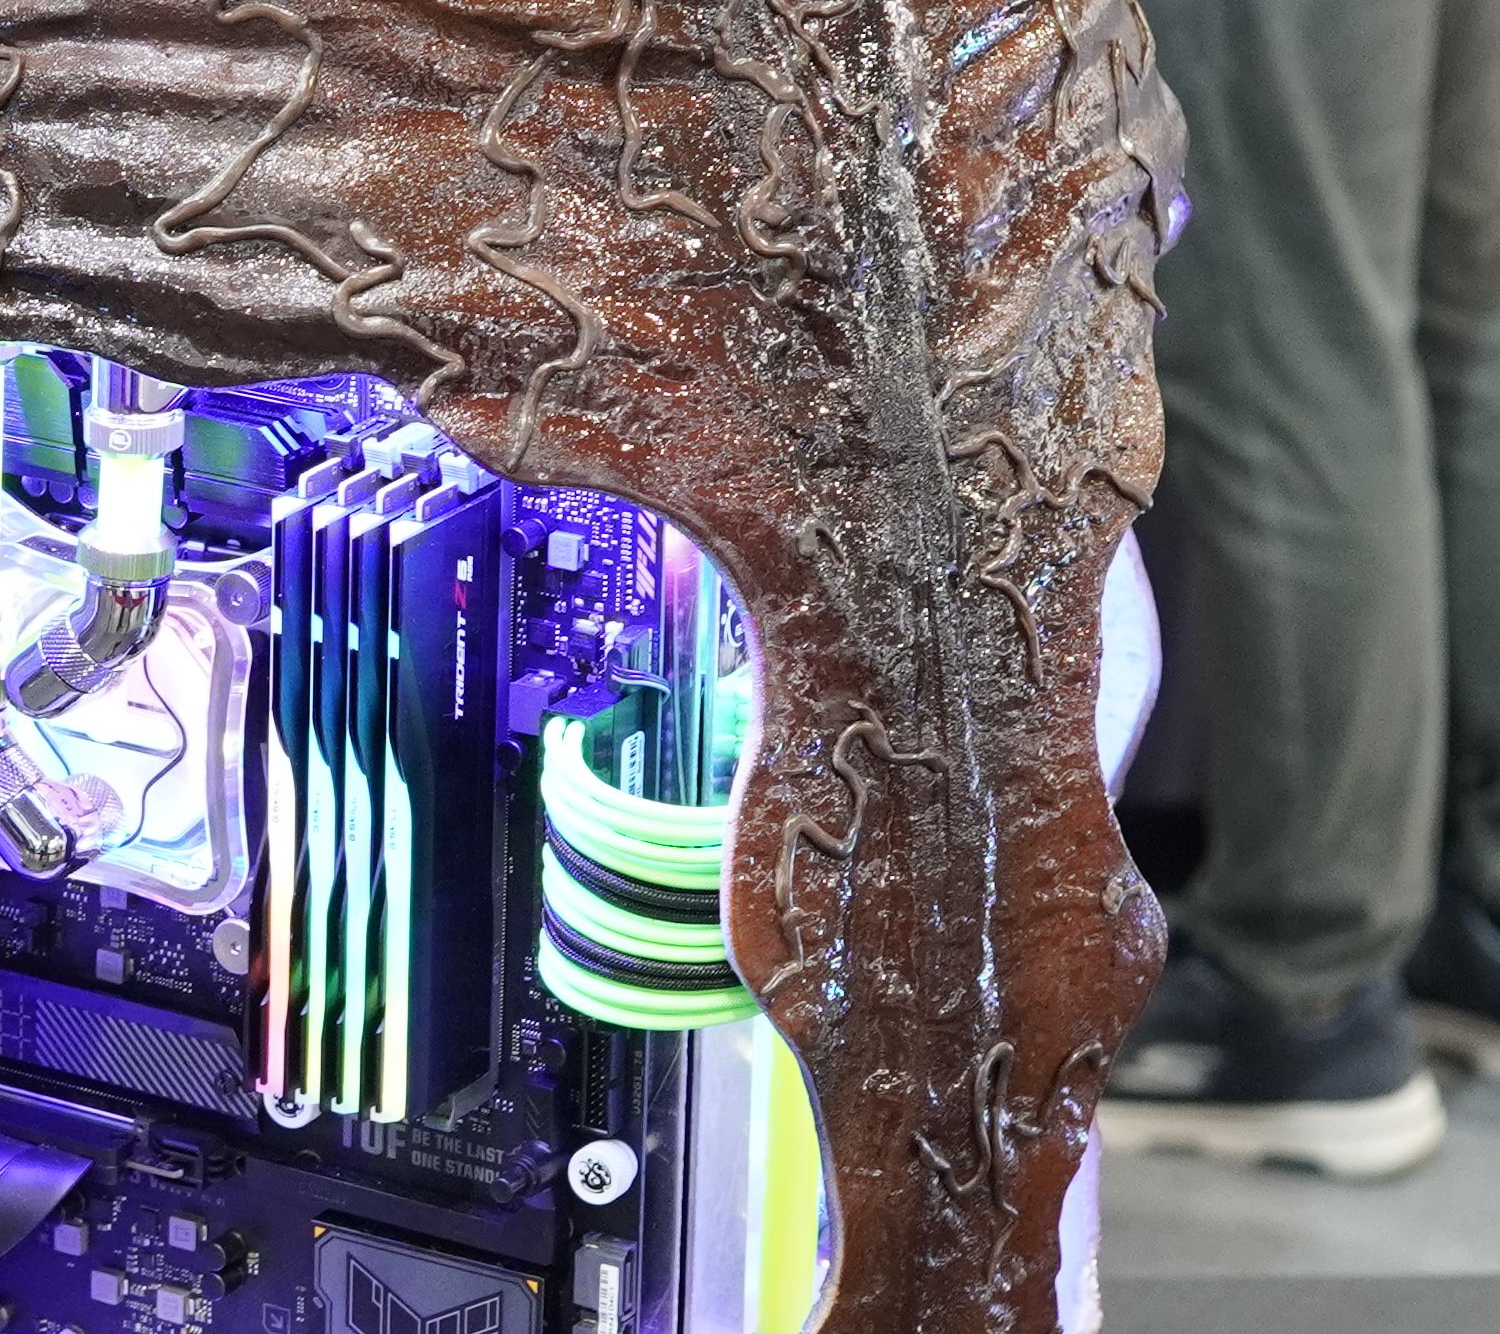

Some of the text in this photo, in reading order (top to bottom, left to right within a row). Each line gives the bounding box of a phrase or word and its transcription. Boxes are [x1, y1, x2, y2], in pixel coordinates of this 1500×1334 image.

[411, 1128, 430, 1146] BE
[437, 1134, 462, 1157] THE
[466, 1142, 505, 1165] LAST
[411, 1150, 501, 1185] ONE STAND
